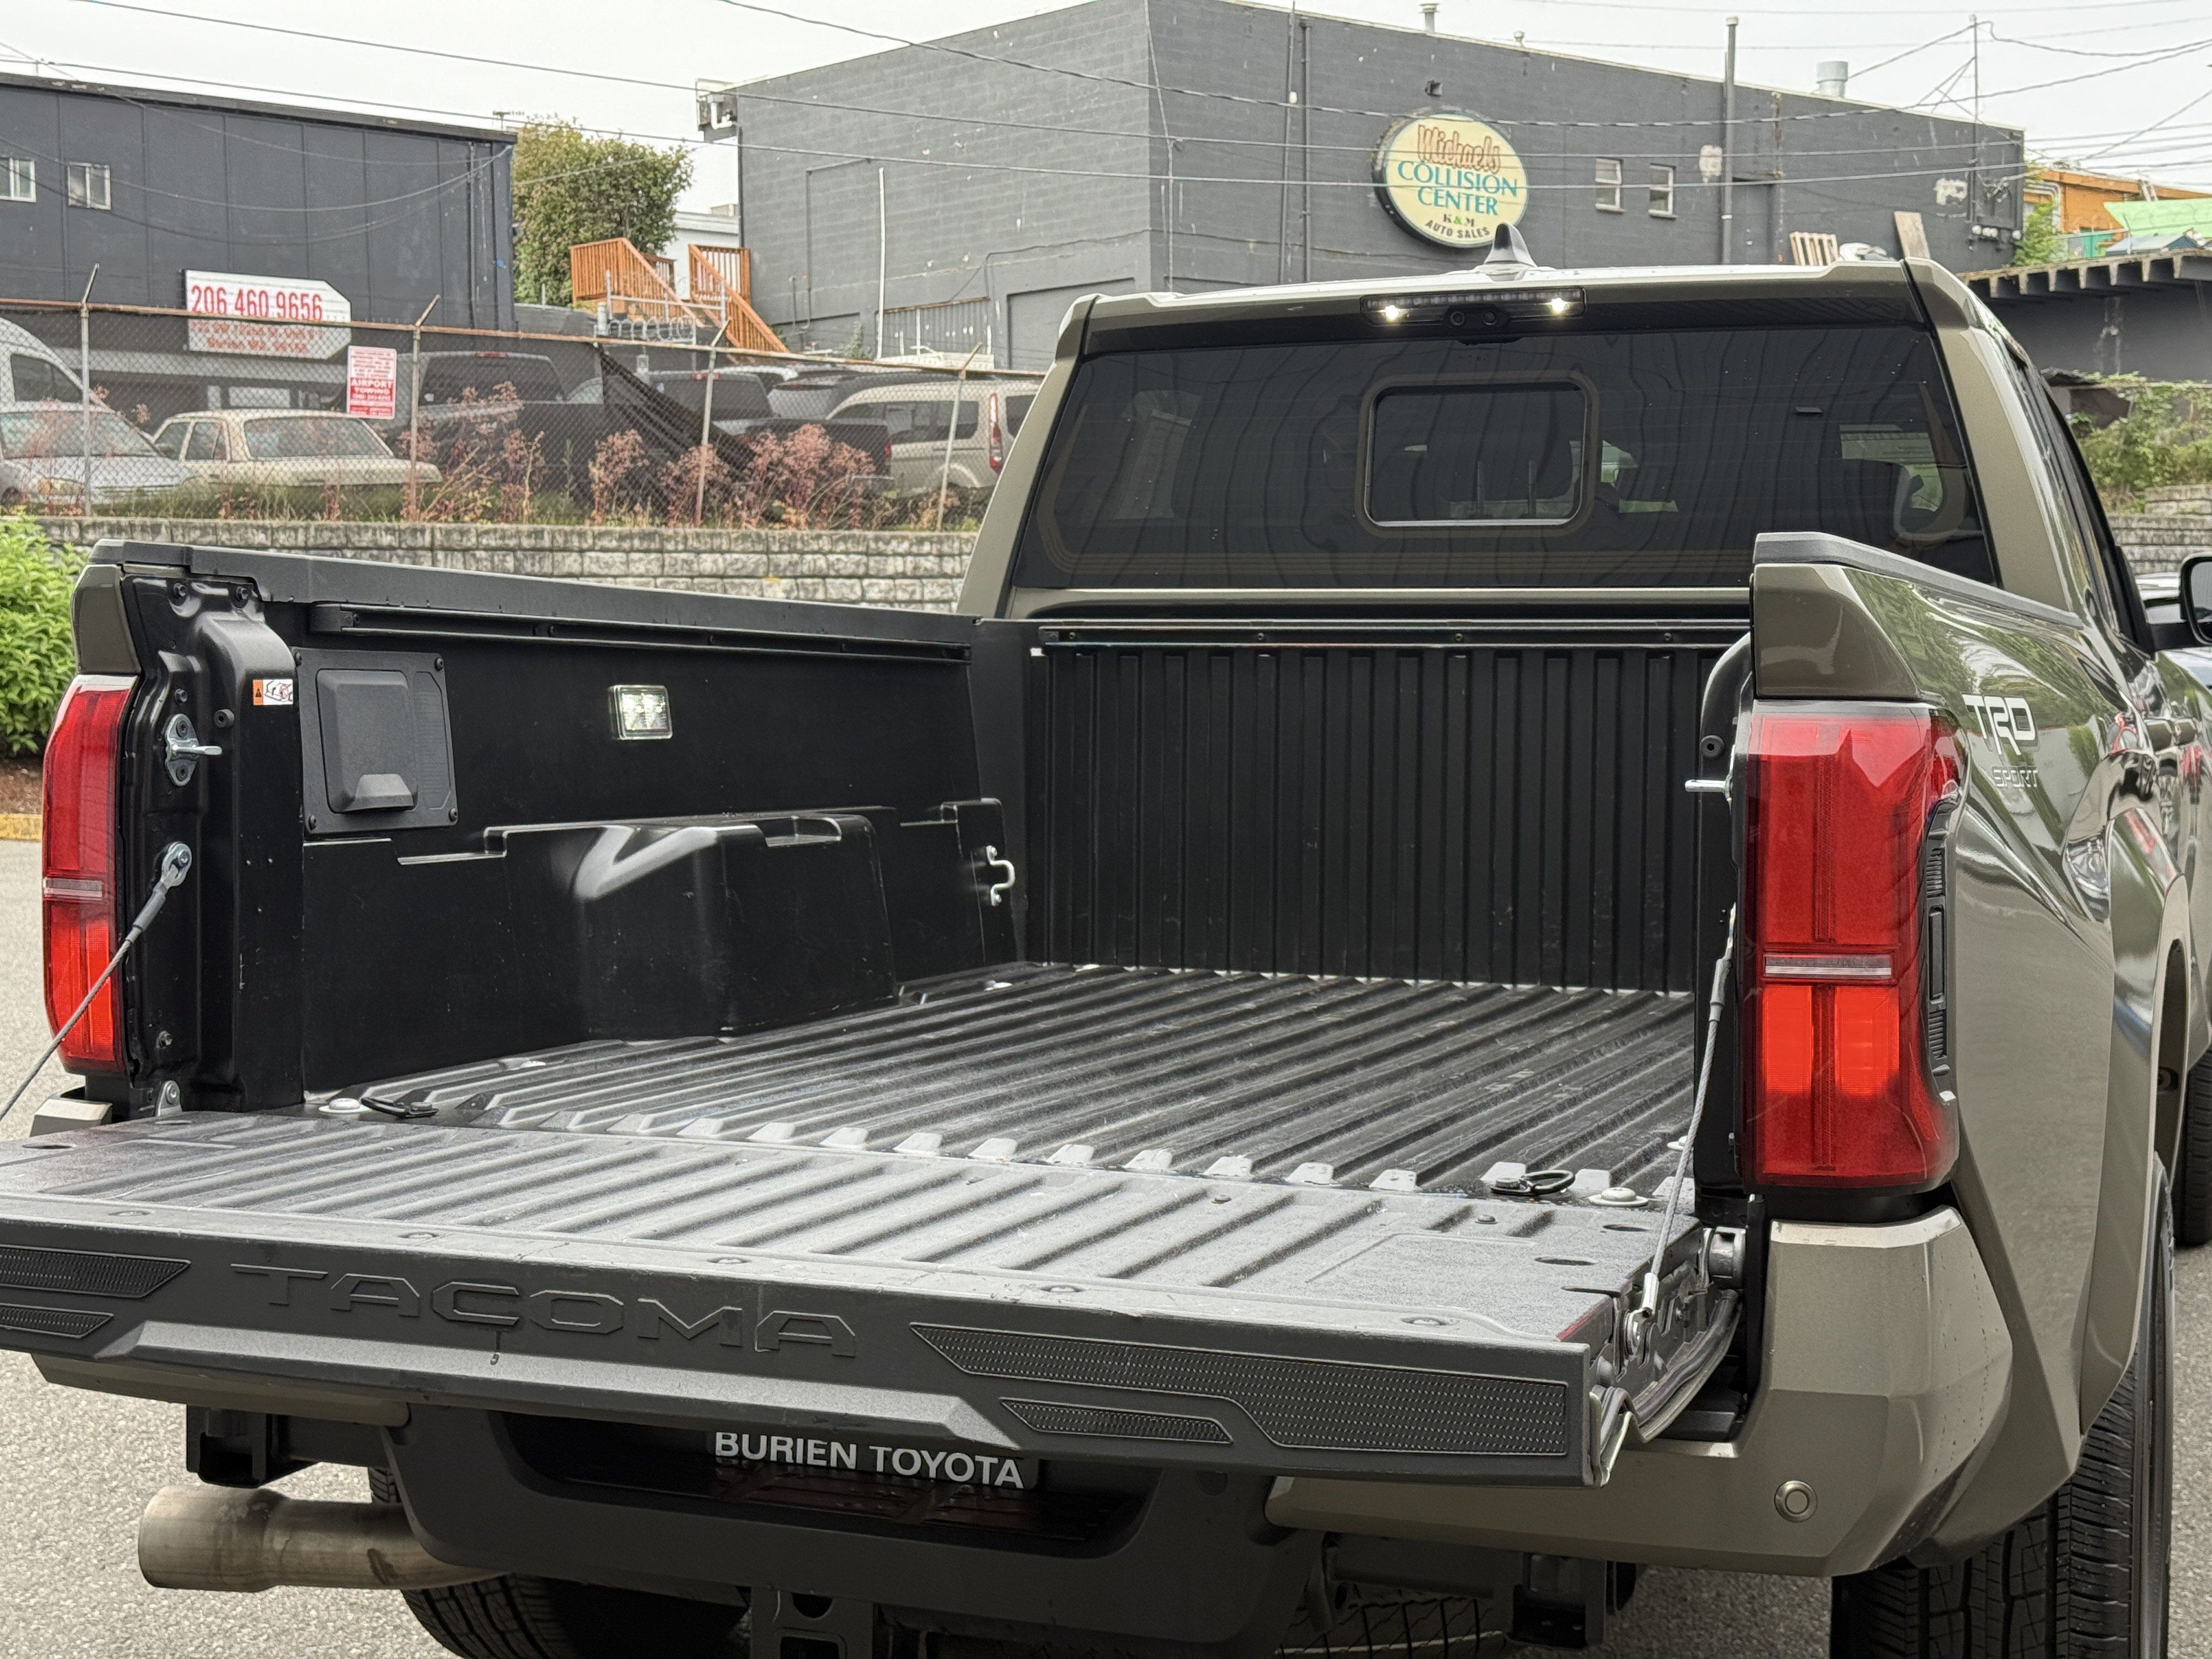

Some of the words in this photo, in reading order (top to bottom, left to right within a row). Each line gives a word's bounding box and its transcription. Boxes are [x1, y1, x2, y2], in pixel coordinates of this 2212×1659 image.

[1398, 161, 1517, 197] COLLISION
[1417, 187, 1499, 216] CENTER
[1425, 219, 1453, 236] AUTO
[1457, 227, 1491, 238] SALES
[191, 285, 227, 314] 206
[235, 289, 269, 318] 460
[276, 291, 323, 321] 9656
[351, 379, 393, 388] AIRPORT
[1962, 694, 2035, 755] TRD
[1993, 769, 2038, 788] SPORT
[230, 1263, 857, 1358] TACOMA
[715, 1432, 857, 1470] BURIEN
[868, 1445, 1024, 1489] TOYOTA
